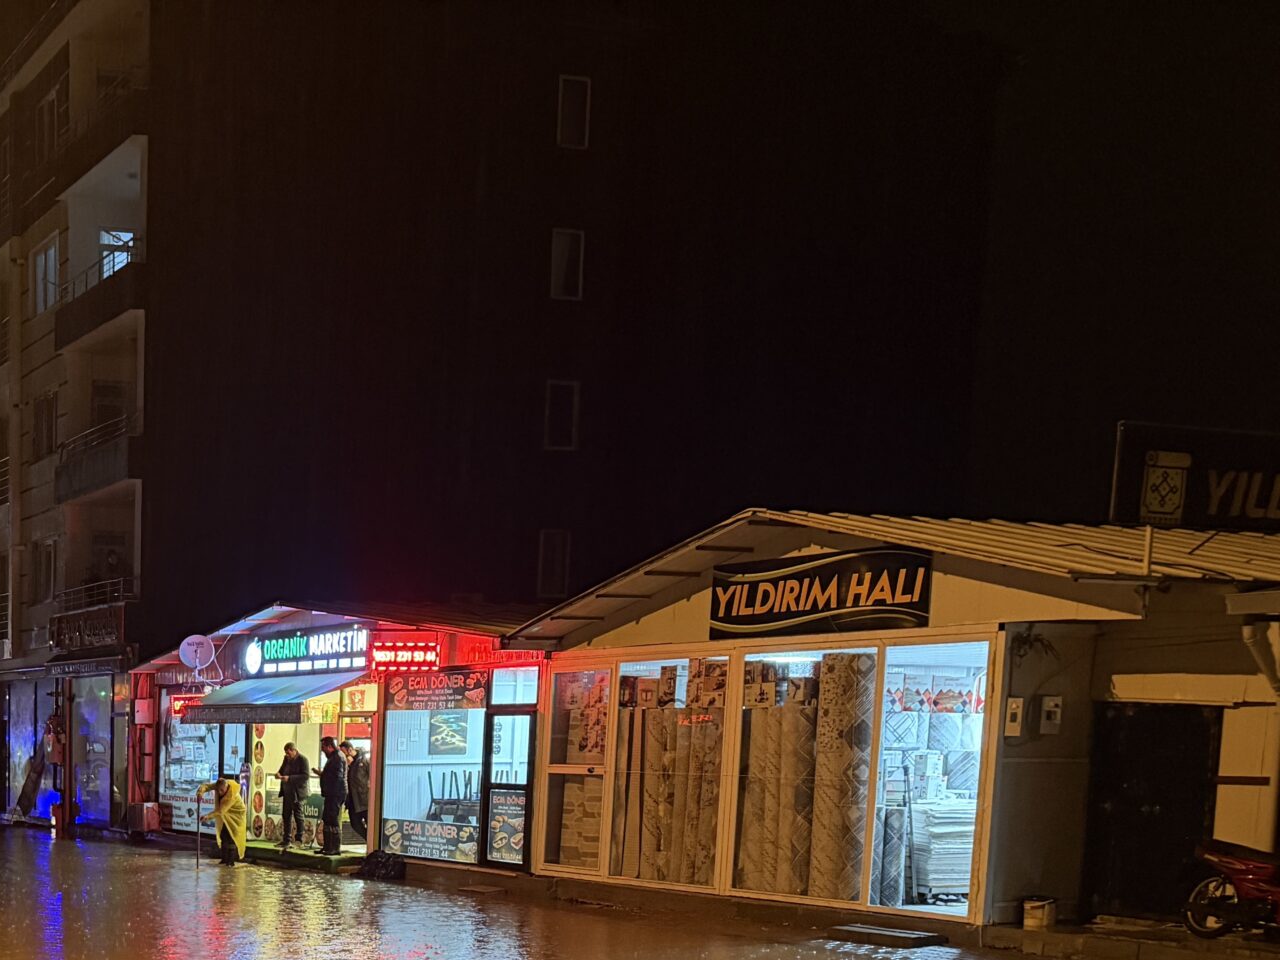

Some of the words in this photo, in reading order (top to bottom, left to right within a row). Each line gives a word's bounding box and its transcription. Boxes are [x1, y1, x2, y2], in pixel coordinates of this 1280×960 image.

[716, 574, 838, 617] YILDIRIM
[846, 567, 925, 607] HALI
[264, 632, 307, 660] ORGANİK
[309, 625, 368, 656] MARKETİM
[396, 651, 412, 662] 231
[409, 677, 428, 689] ECM
[431, 674, 464, 688] DÖNER
[427, 702, 437, 710] 231
[305, 805, 318, 816] Usta
[403, 822, 422, 834] ECM
[425, 822, 457, 838] DÖNER
[408, 847, 420, 855] 0531
[421, 848, 431, 857] 231
[441, 850, 448, 858] 44
